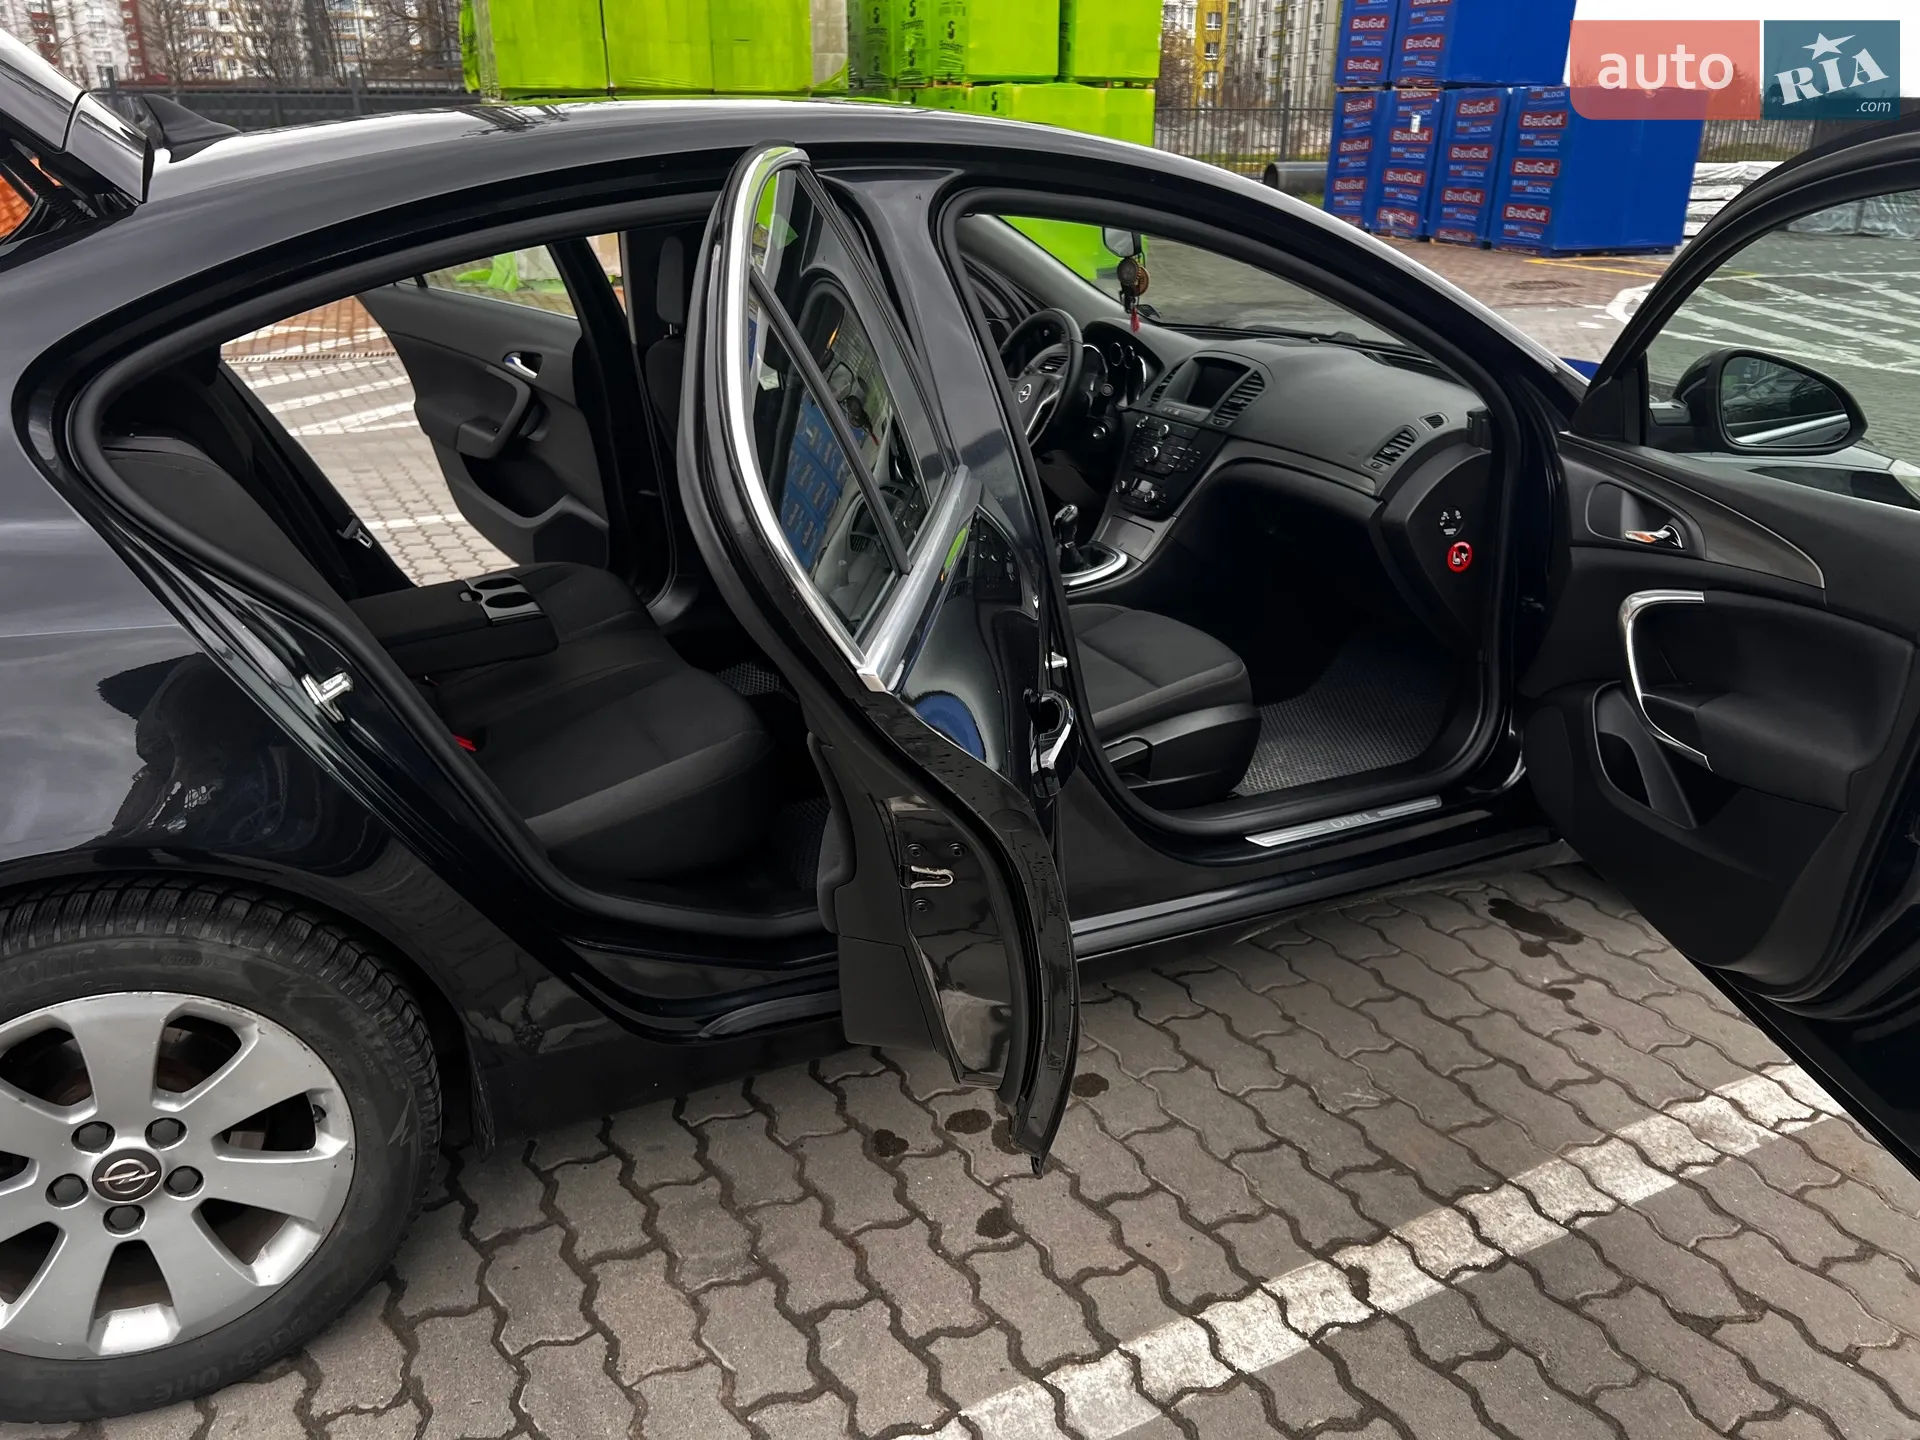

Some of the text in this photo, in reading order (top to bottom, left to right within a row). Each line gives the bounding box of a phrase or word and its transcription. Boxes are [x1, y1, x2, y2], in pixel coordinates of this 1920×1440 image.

[1352, 18, 1385, 29] BauGut
[1405, 37, 1441, 49] BauGut
[1460, 101, 1495, 114] BauGut
[1523, 114, 1563, 126] BauGut
[1451, 147, 1488, 159] BauGut
[1514, 161, 1555, 174] BauGut
[1445, 190, 1480, 203] BauGut
[1506, 206, 1547, 220] BauGut
